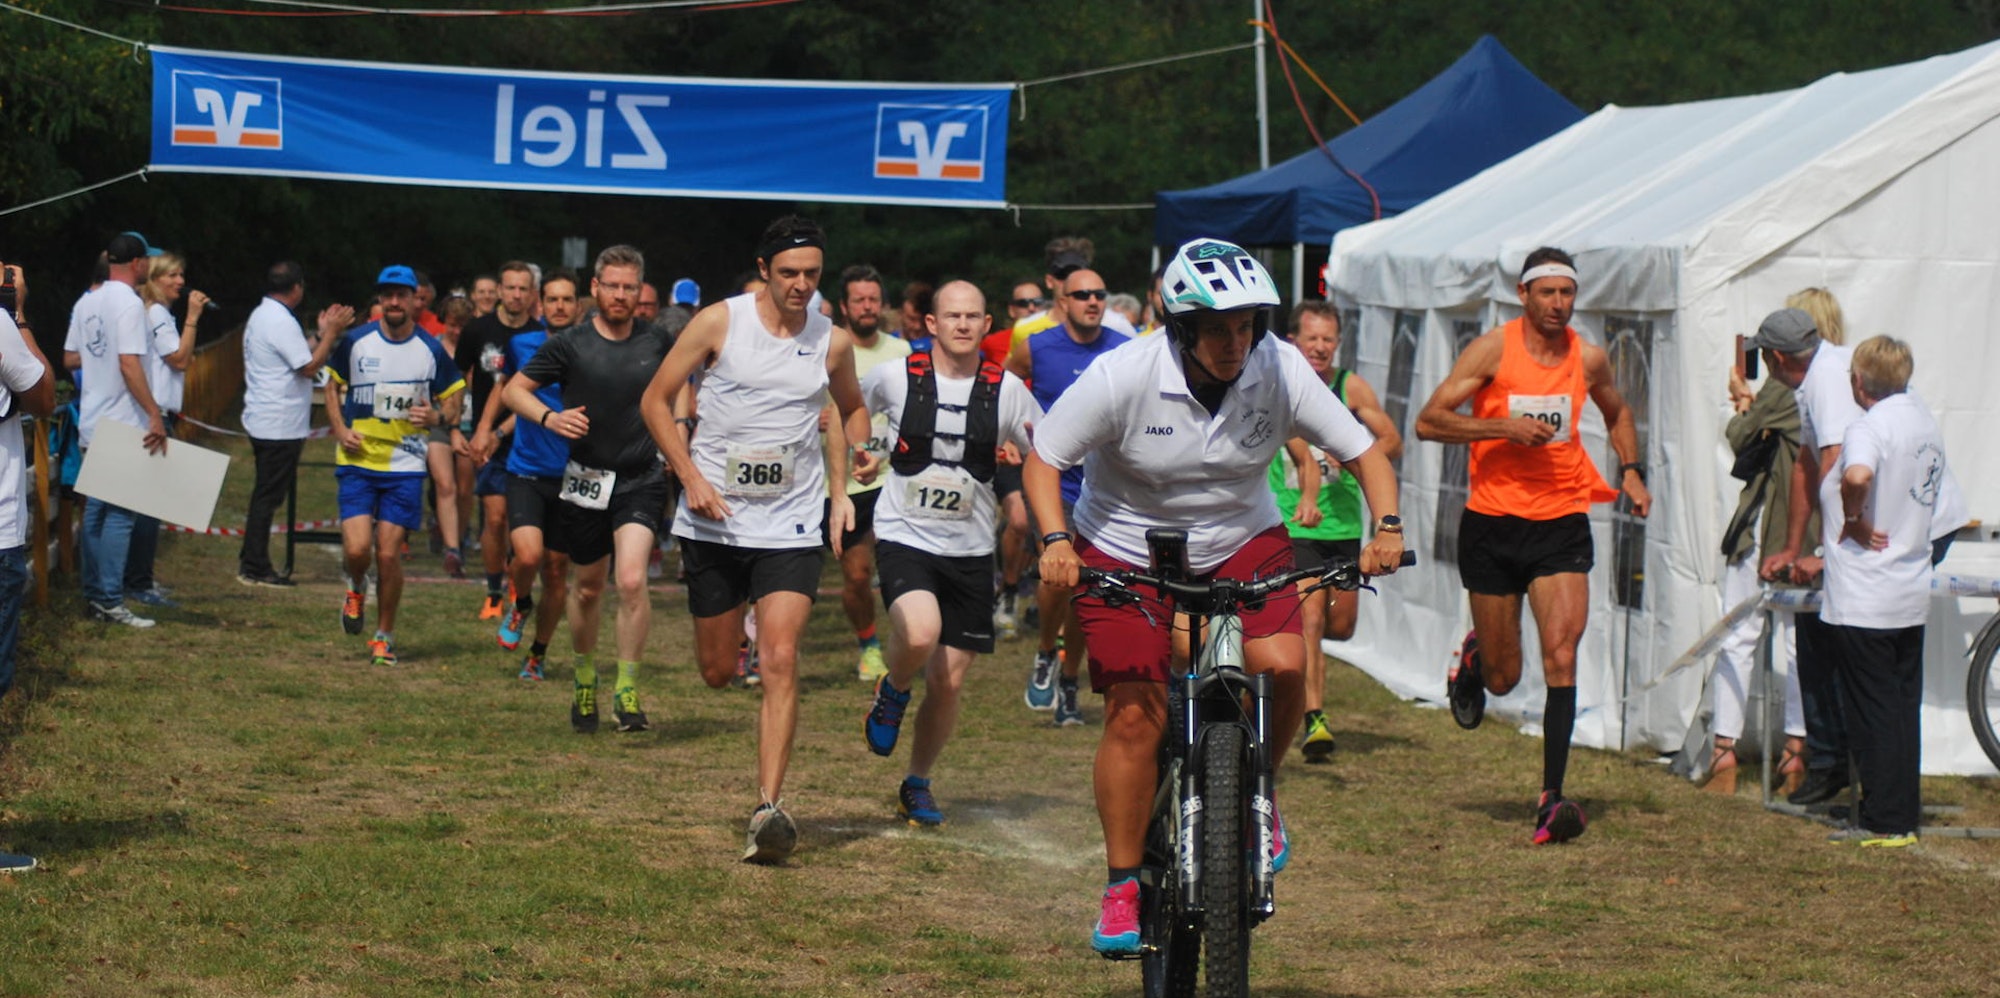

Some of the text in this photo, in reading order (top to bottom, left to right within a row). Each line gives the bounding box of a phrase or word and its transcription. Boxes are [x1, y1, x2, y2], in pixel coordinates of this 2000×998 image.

[1144, 425, 1174, 437] JAKO
[737, 462, 783, 486] 368
[567, 475, 602, 500] 369
[918, 486, 962, 512] 122
